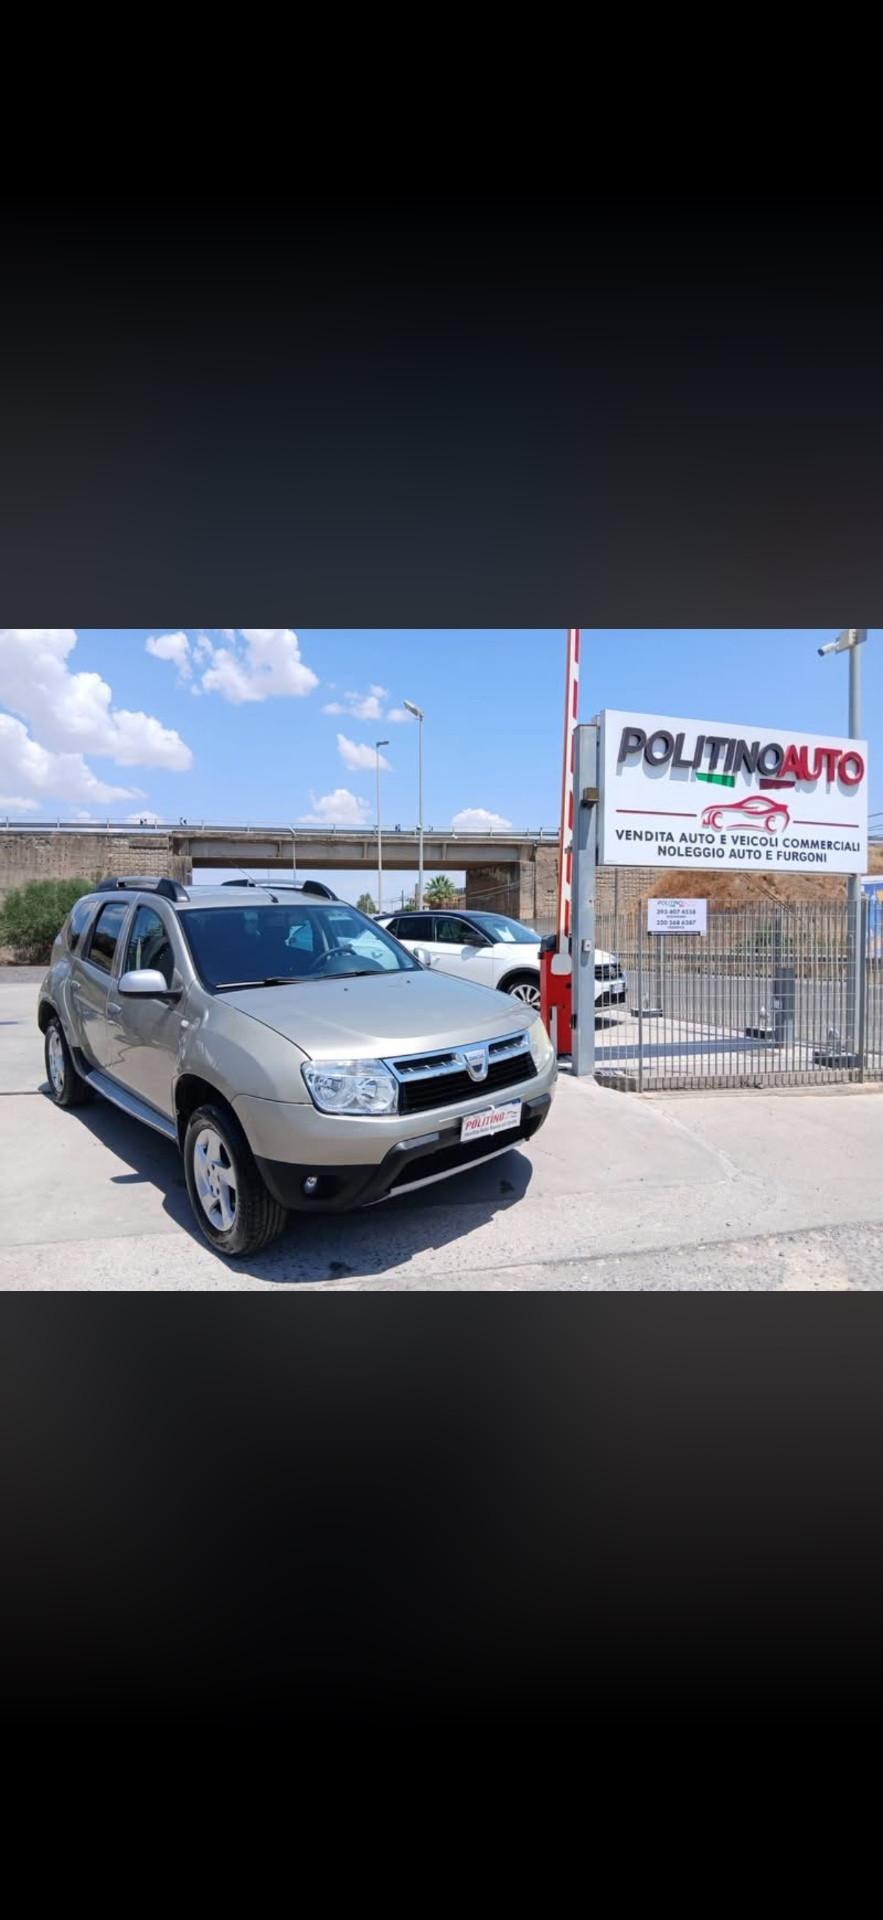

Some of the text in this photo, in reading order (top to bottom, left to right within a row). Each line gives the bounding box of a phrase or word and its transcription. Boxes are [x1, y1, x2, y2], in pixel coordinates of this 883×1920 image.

[616, 829, 860, 852] VENDITA AUTO E VEICOLI COMMERCIALI
[657, 845, 827, 863] NOLEGGIO AUTO E FURGONI
[465, 1112, 505, 1130] POLITINO
